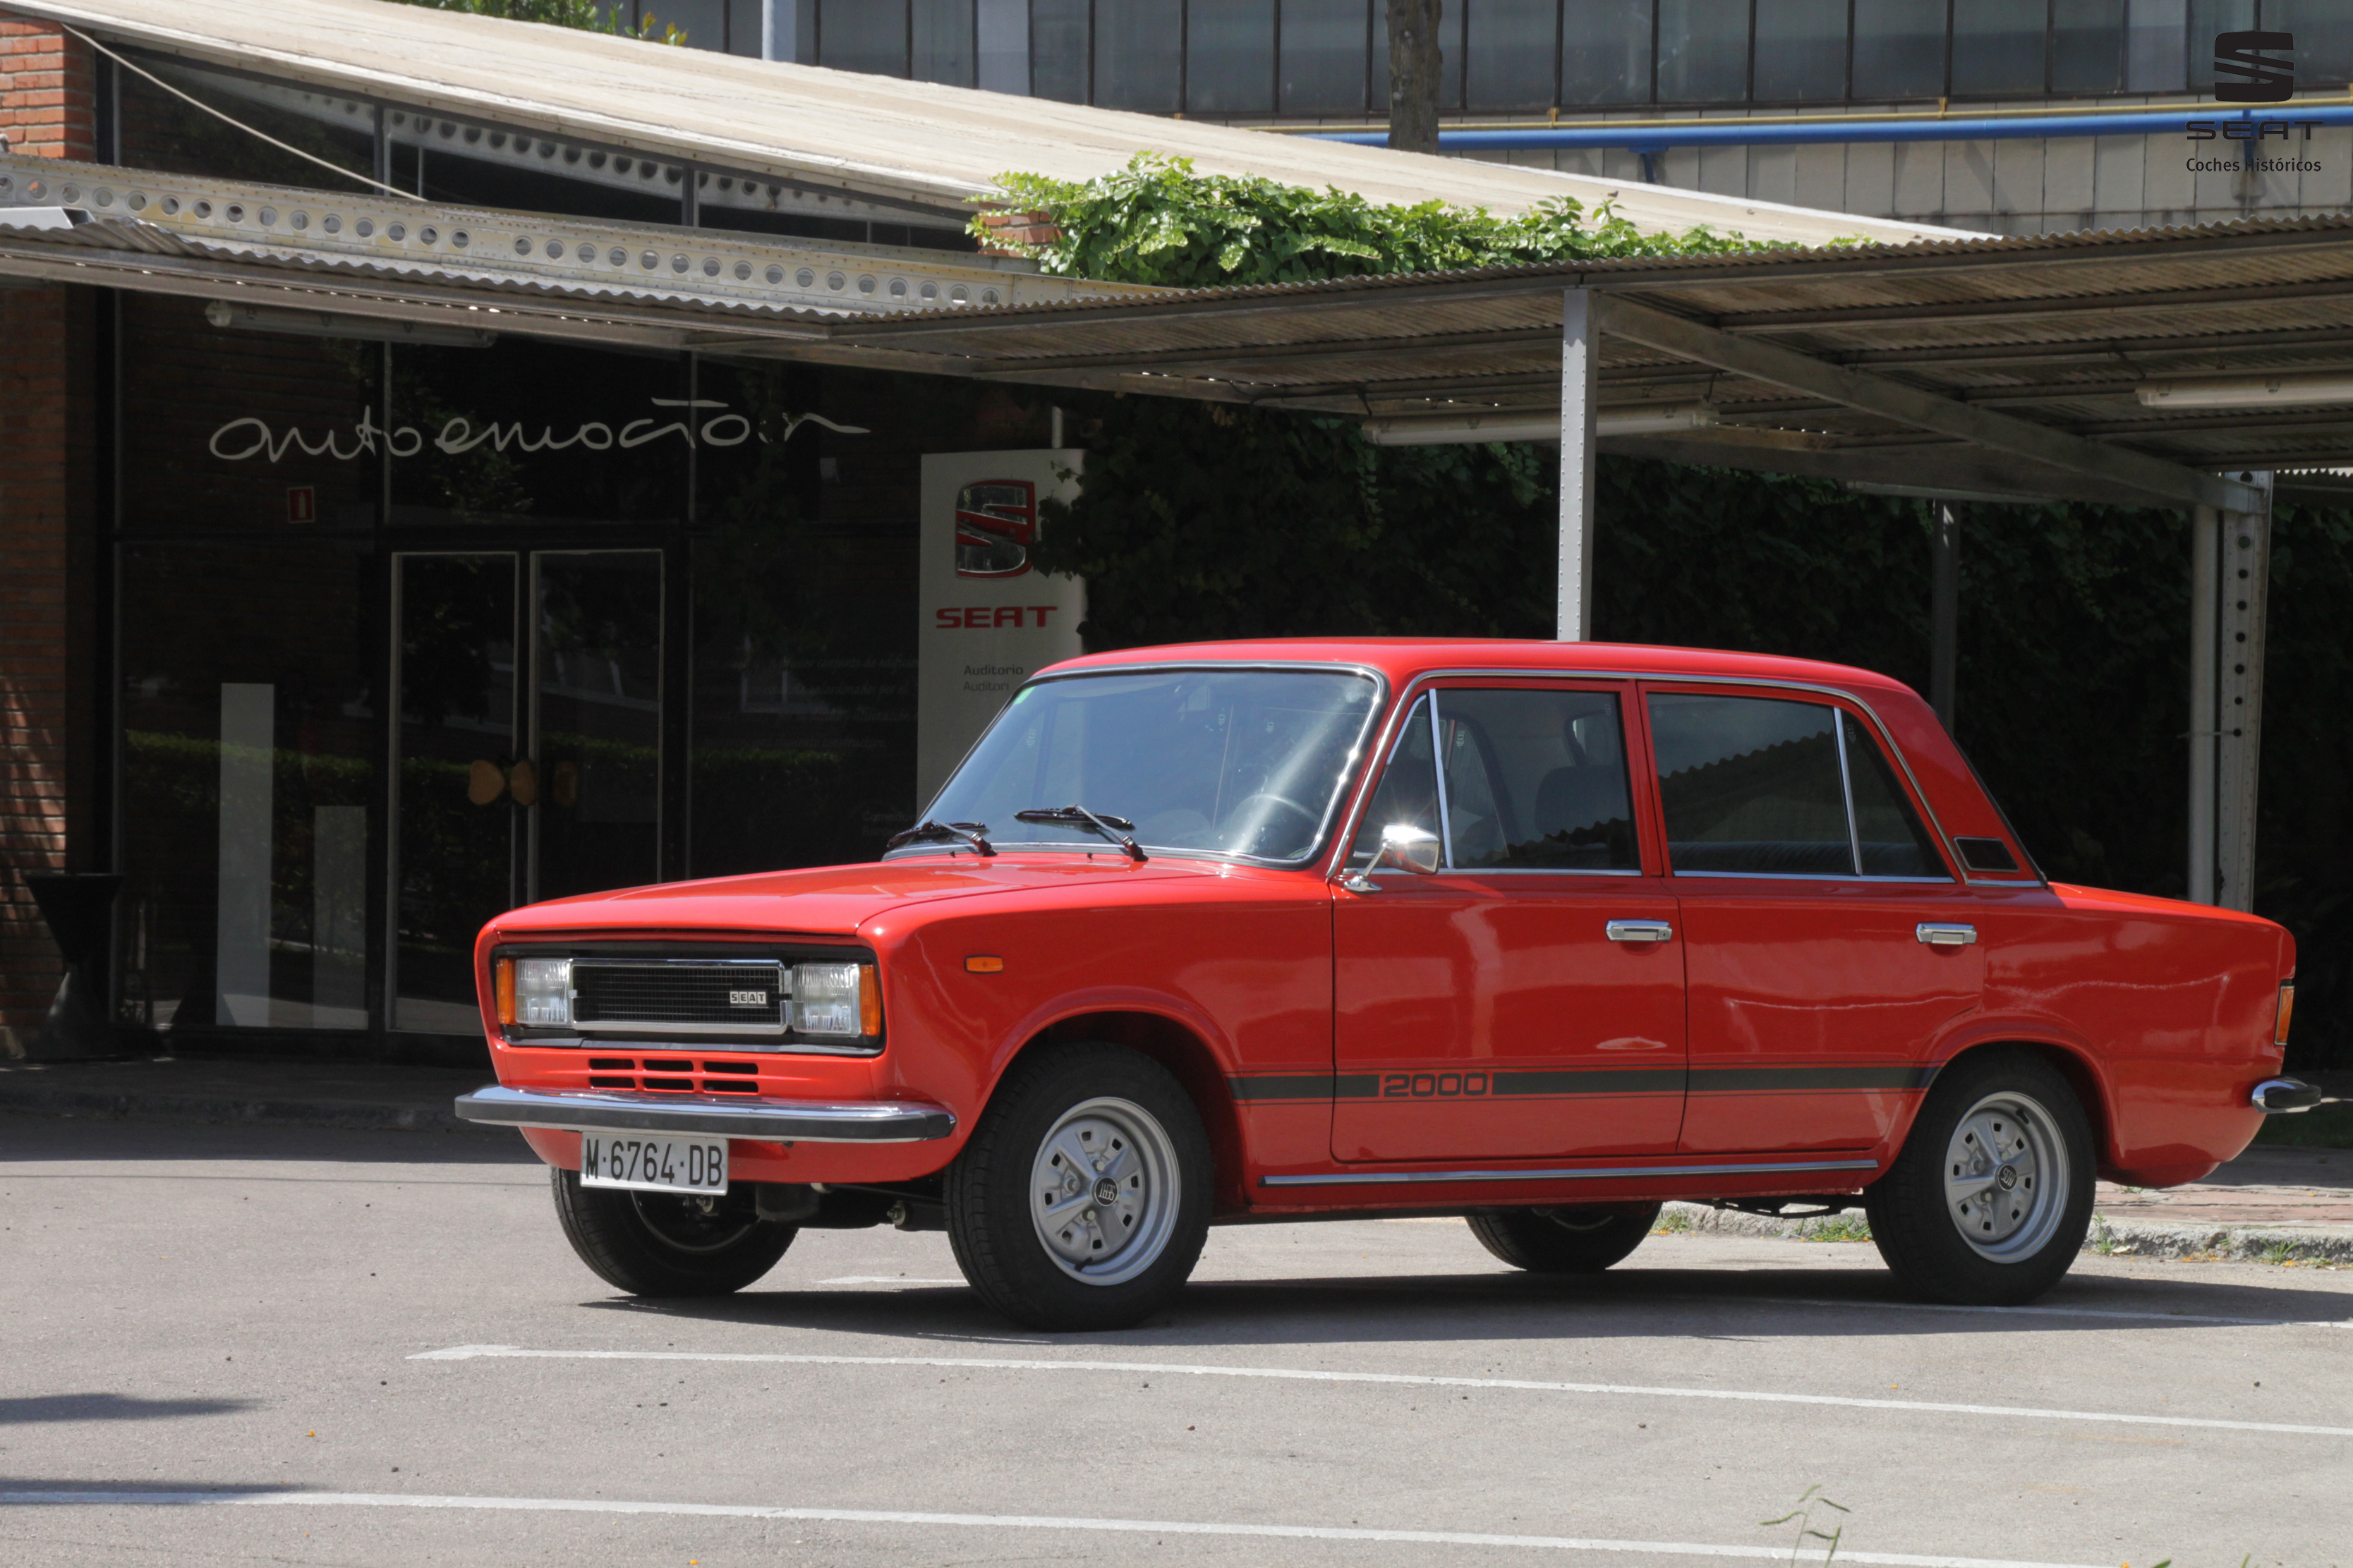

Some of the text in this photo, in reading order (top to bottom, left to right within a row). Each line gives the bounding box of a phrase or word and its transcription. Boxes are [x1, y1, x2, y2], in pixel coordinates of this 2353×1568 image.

[936, 606, 1058, 628] SEAT
[964, 664, 1024, 676] Auditorio
[963, 681, 1010, 692] Auditori
[730, 992, 766, 1003] SEAT
[1384, 1072, 1488, 1098] 2000
